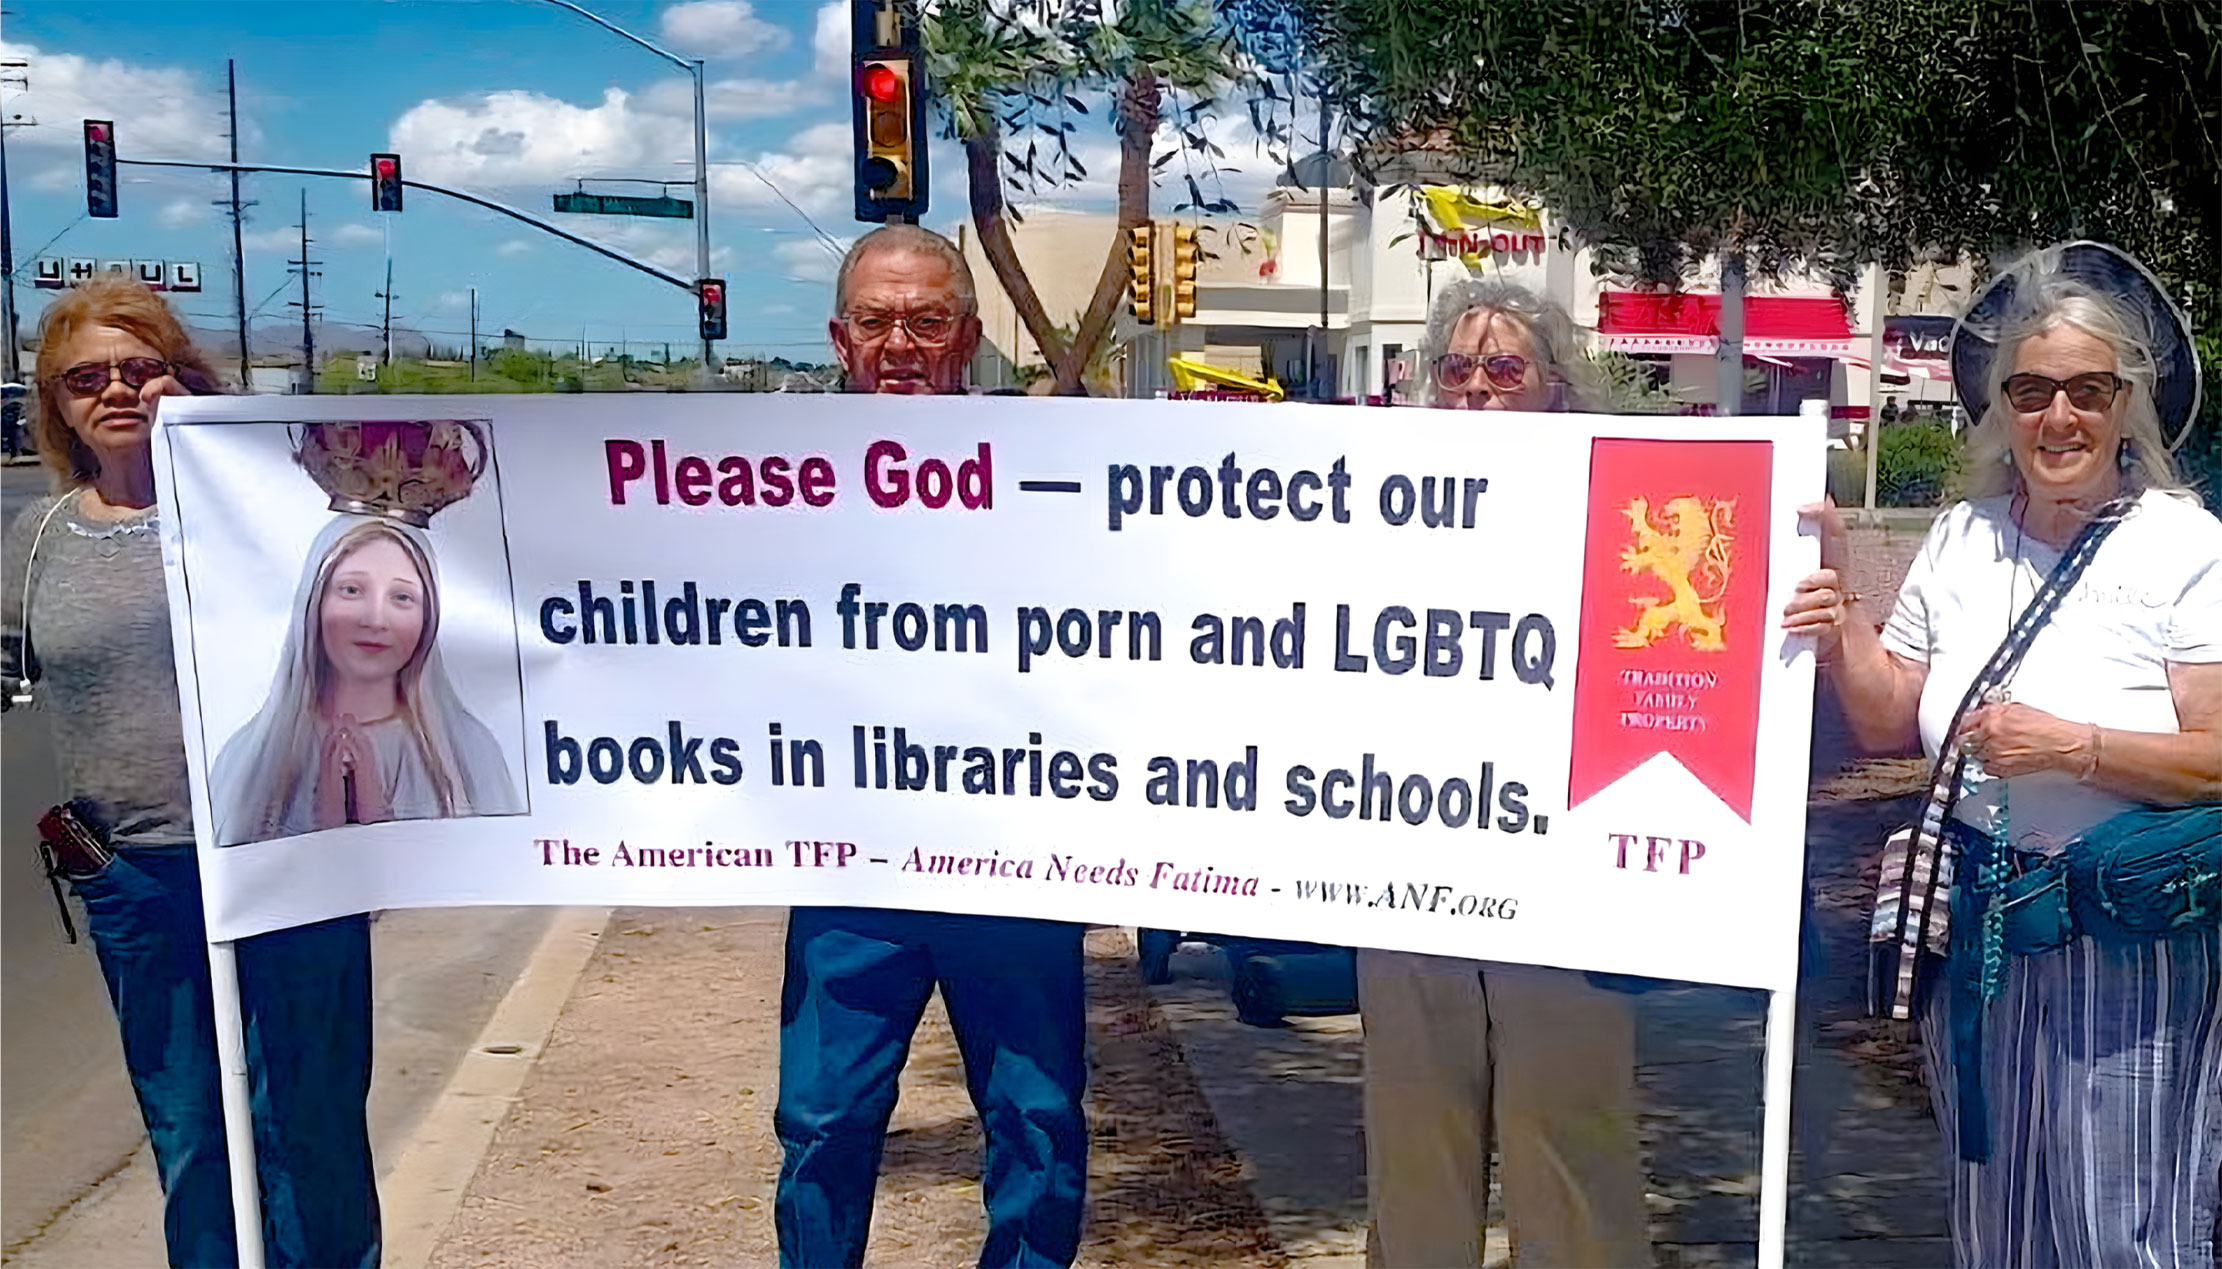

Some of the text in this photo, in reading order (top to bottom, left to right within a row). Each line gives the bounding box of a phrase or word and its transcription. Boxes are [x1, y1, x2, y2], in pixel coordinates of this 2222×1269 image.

[604, 439, 835, 508] Please
[863, 439, 993, 511] God
[1108, 451, 1352, 532] protect
[1379, 474, 1489, 530] our
[540, 579, 1556, 691] children from porn and LGBTQ
[544, 719, 1549, 836] books in libraries and schools.
[534, 839, 600, 867] The
[611, 838, 774, 868] American
[784, 840, 858, 868] TFP
[902, 845, 1033, 880] America
[1045, 853, 1140, 888] Needs
[1149, 861, 1259, 897] Fatima
[1608, 832, 1707, 875] TFP
